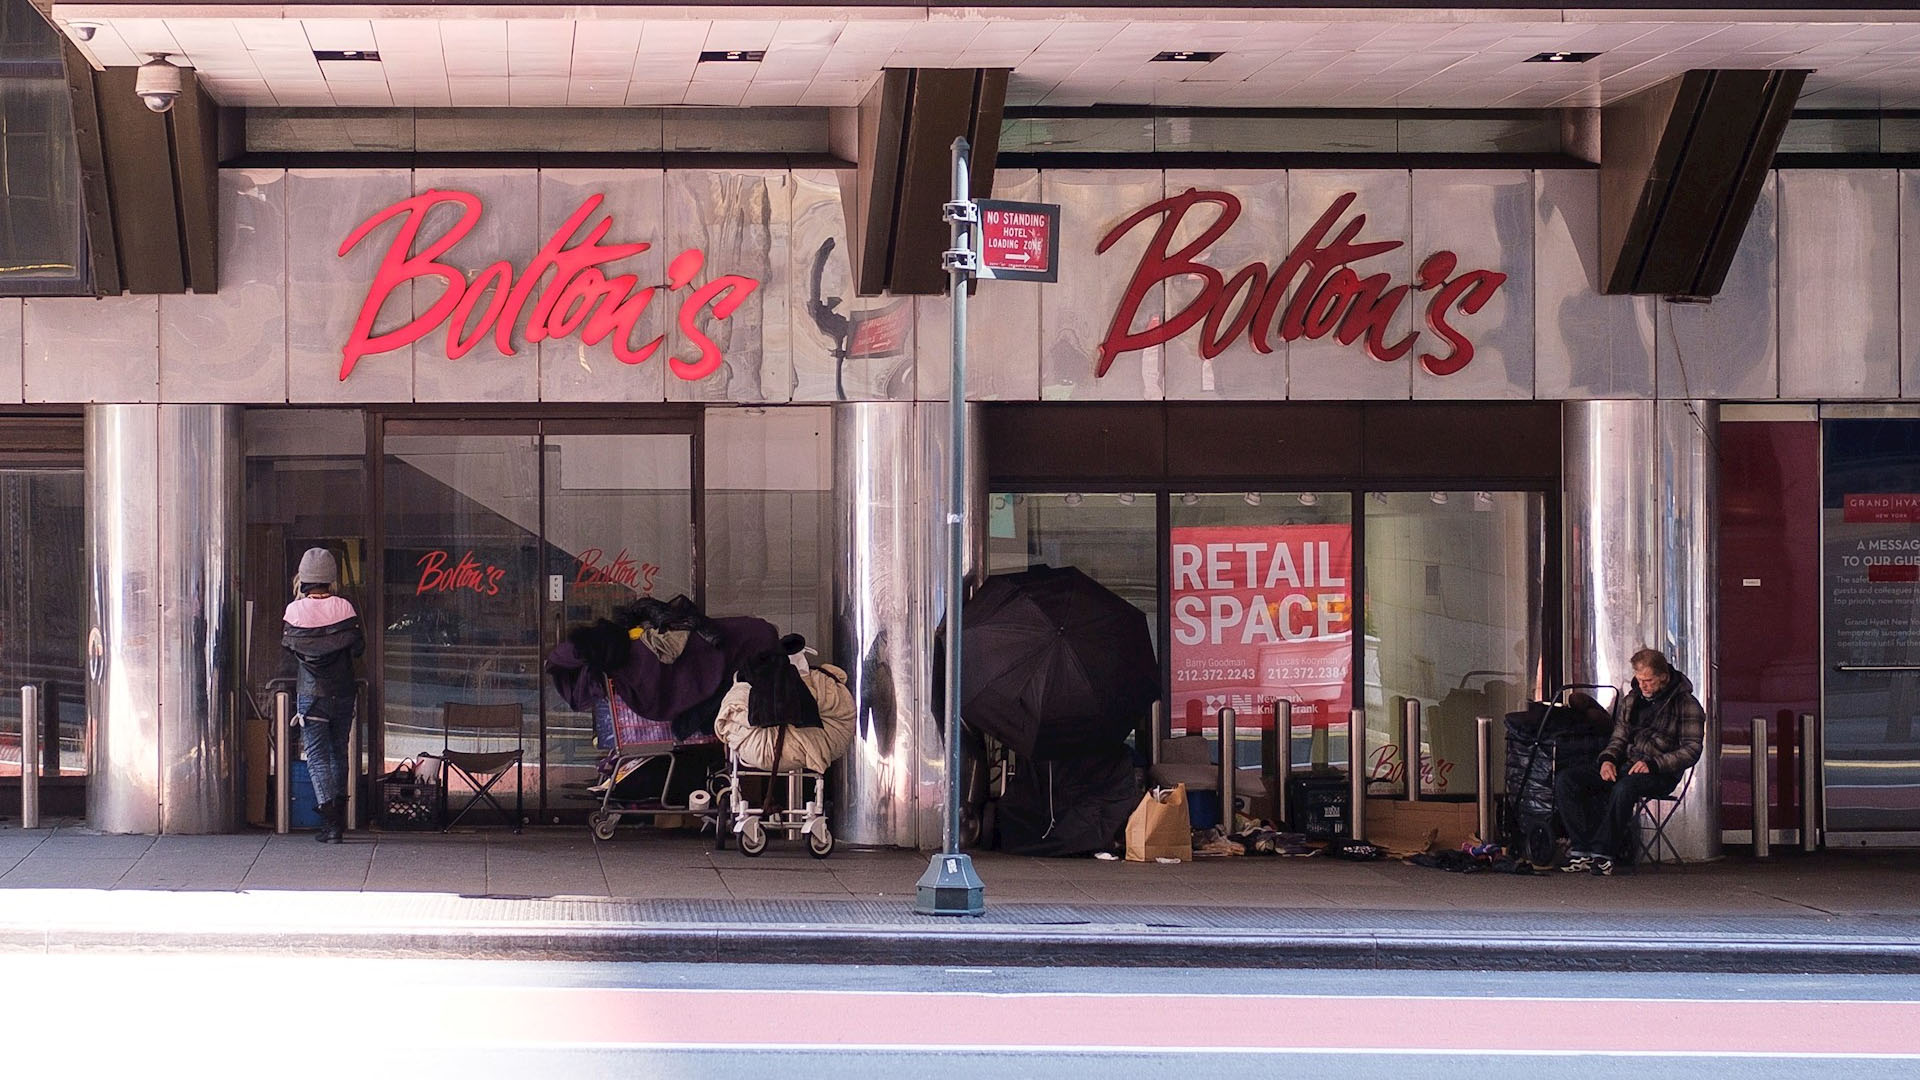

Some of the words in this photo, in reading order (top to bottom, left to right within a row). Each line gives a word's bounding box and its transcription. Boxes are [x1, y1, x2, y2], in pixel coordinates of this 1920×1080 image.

[987, 211, 999, 224] NO
[1003, 212, 1045, 228] STANDING
[1003, 228, 1027, 238] HOTEL
[988, 238, 1019, 250] LOADING
[1023, 240, 1042, 251] ZONE
[338, 188, 760, 382] Bolton's
[1096, 187, 1507, 377] Bolton's
[1850, 499, 1889, 507] GRAND
[1895, 499, 1920, 507] HYA
[1857, 540, 1865, 550] A
[1869, 539, 1920, 550] MESSAG
[1173, 542, 1345, 590] RETAIL
[1842, 556, 1859, 566] TO
[1863, 555, 1890, 566] OUR
[1894, 555, 1920, 566] GUE
[417, 550, 506, 596] Bolton's
[573, 548, 659, 592] Bolton's
[1833, 588, 1857, 596] guests
[1874, 586, 1912, 595] colleagues
[1174, 594, 1346, 646] SPACE
[1844, 617, 1868, 625] Grand
[1870, 617, 1890, 627] Hyatt
[1185, 658, 1206, 669] Barry
[1208, 657, 1246, 668] Goodman
[1276, 656, 1298, 665] Lucas
[1177, 669, 1255, 681] 212.372.2243
[1268, 667, 1346, 679] 212.372.2384
[1291, 704, 1318, 714] Frank
[1369, 744, 1455, 787] Bon's
